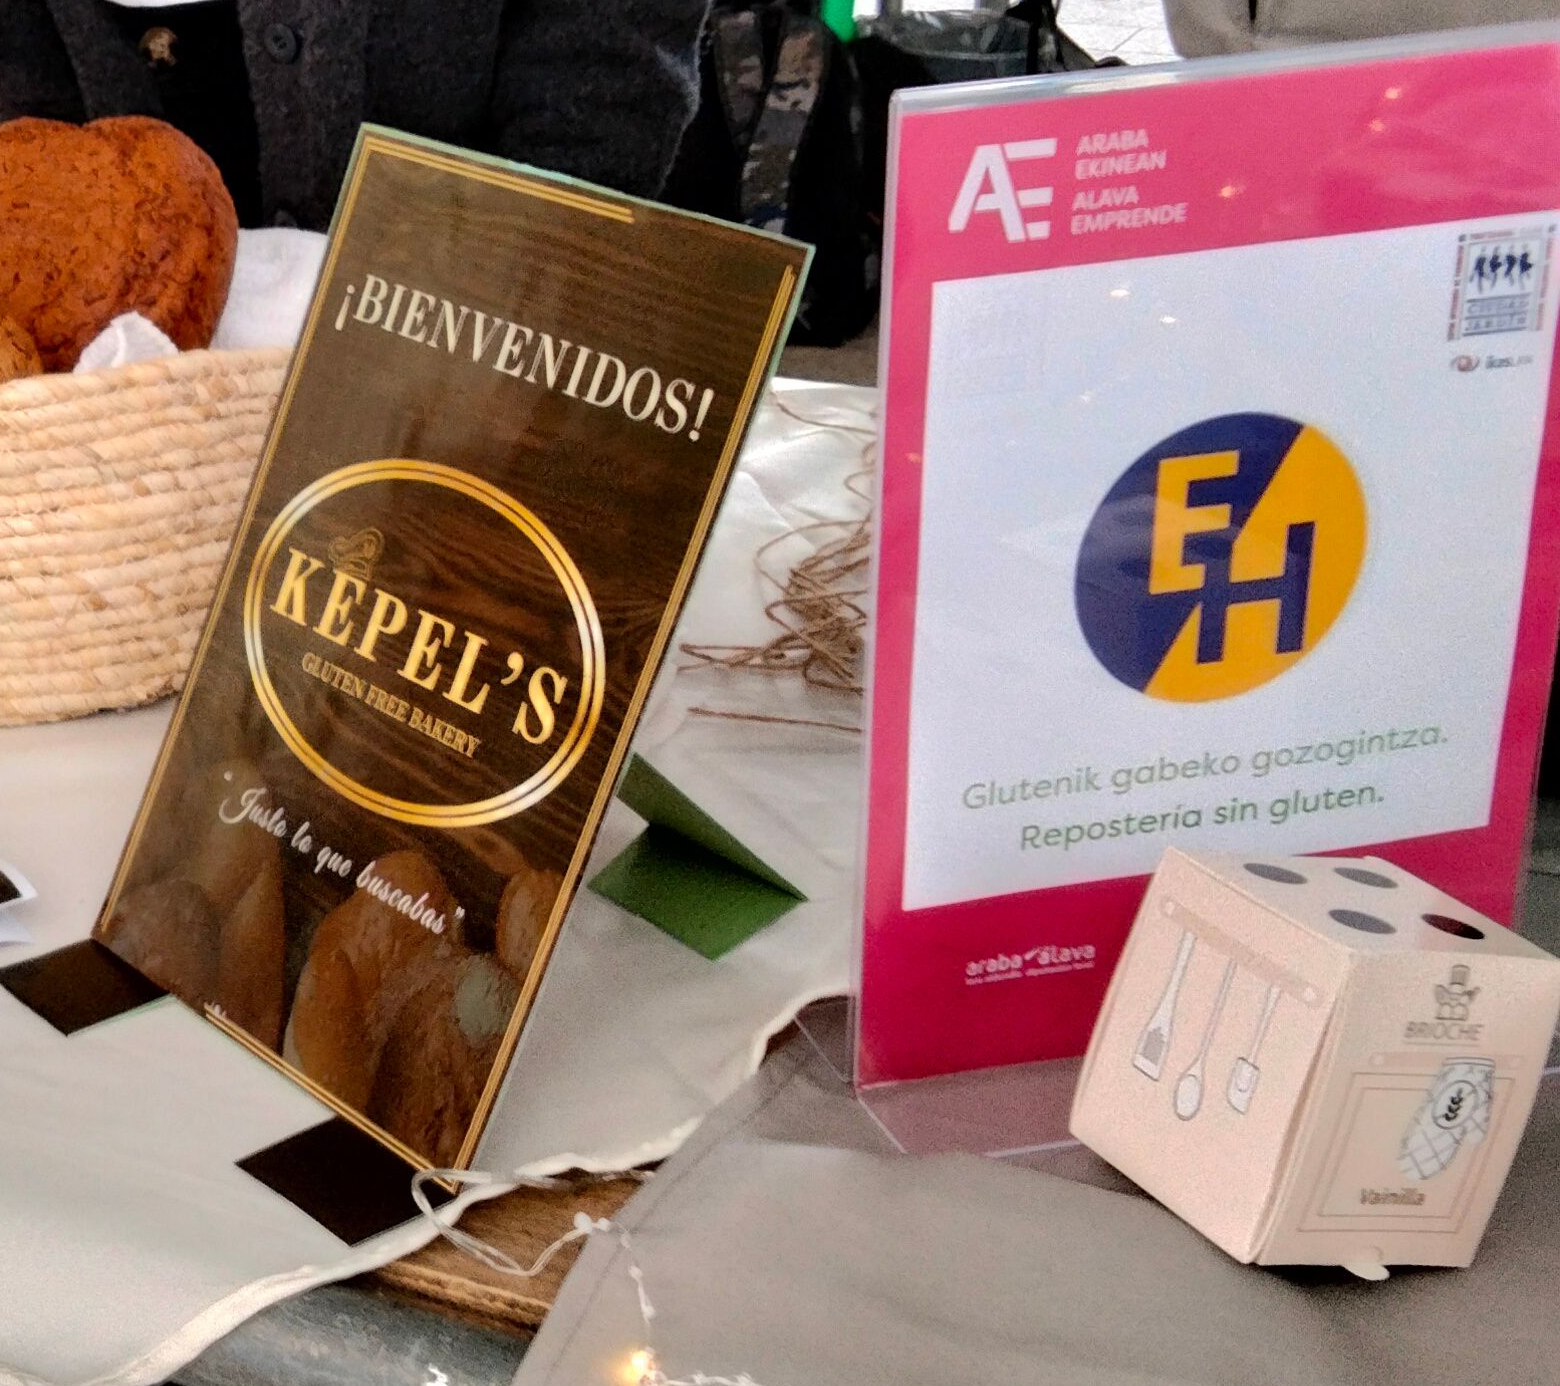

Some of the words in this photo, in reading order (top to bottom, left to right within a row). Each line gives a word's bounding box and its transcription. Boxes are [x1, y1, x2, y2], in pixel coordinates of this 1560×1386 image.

[1074, 149, 1168, 180] EKINEAN
[1076, 129, 1149, 156] ARABA
[1070, 202, 1188, 235] EMPRENDE
[335, 274, 714, 442] ¡BIENVENIDOS!
[269, 547, 569, 745] KEPEL'S
[301, 651, 364, 701] GLUTEN
[364, 682, 410, 723] FREE
[408, 707, 482, 759] BAKERY
[962, 766, 1102, 810] Glutenik
[1111, 752, 1241, 795] gabeko
[1251, 725, 1448, 778] gozogintza.
[1213, 797, 1258, 825] sin
[1269, 784, 1385, 825] gluten.
[291, 820, 312, 854] lo
[313, 845, 352, 878] que
[1404, 1021, 1485, 1041] BRIOCHE
